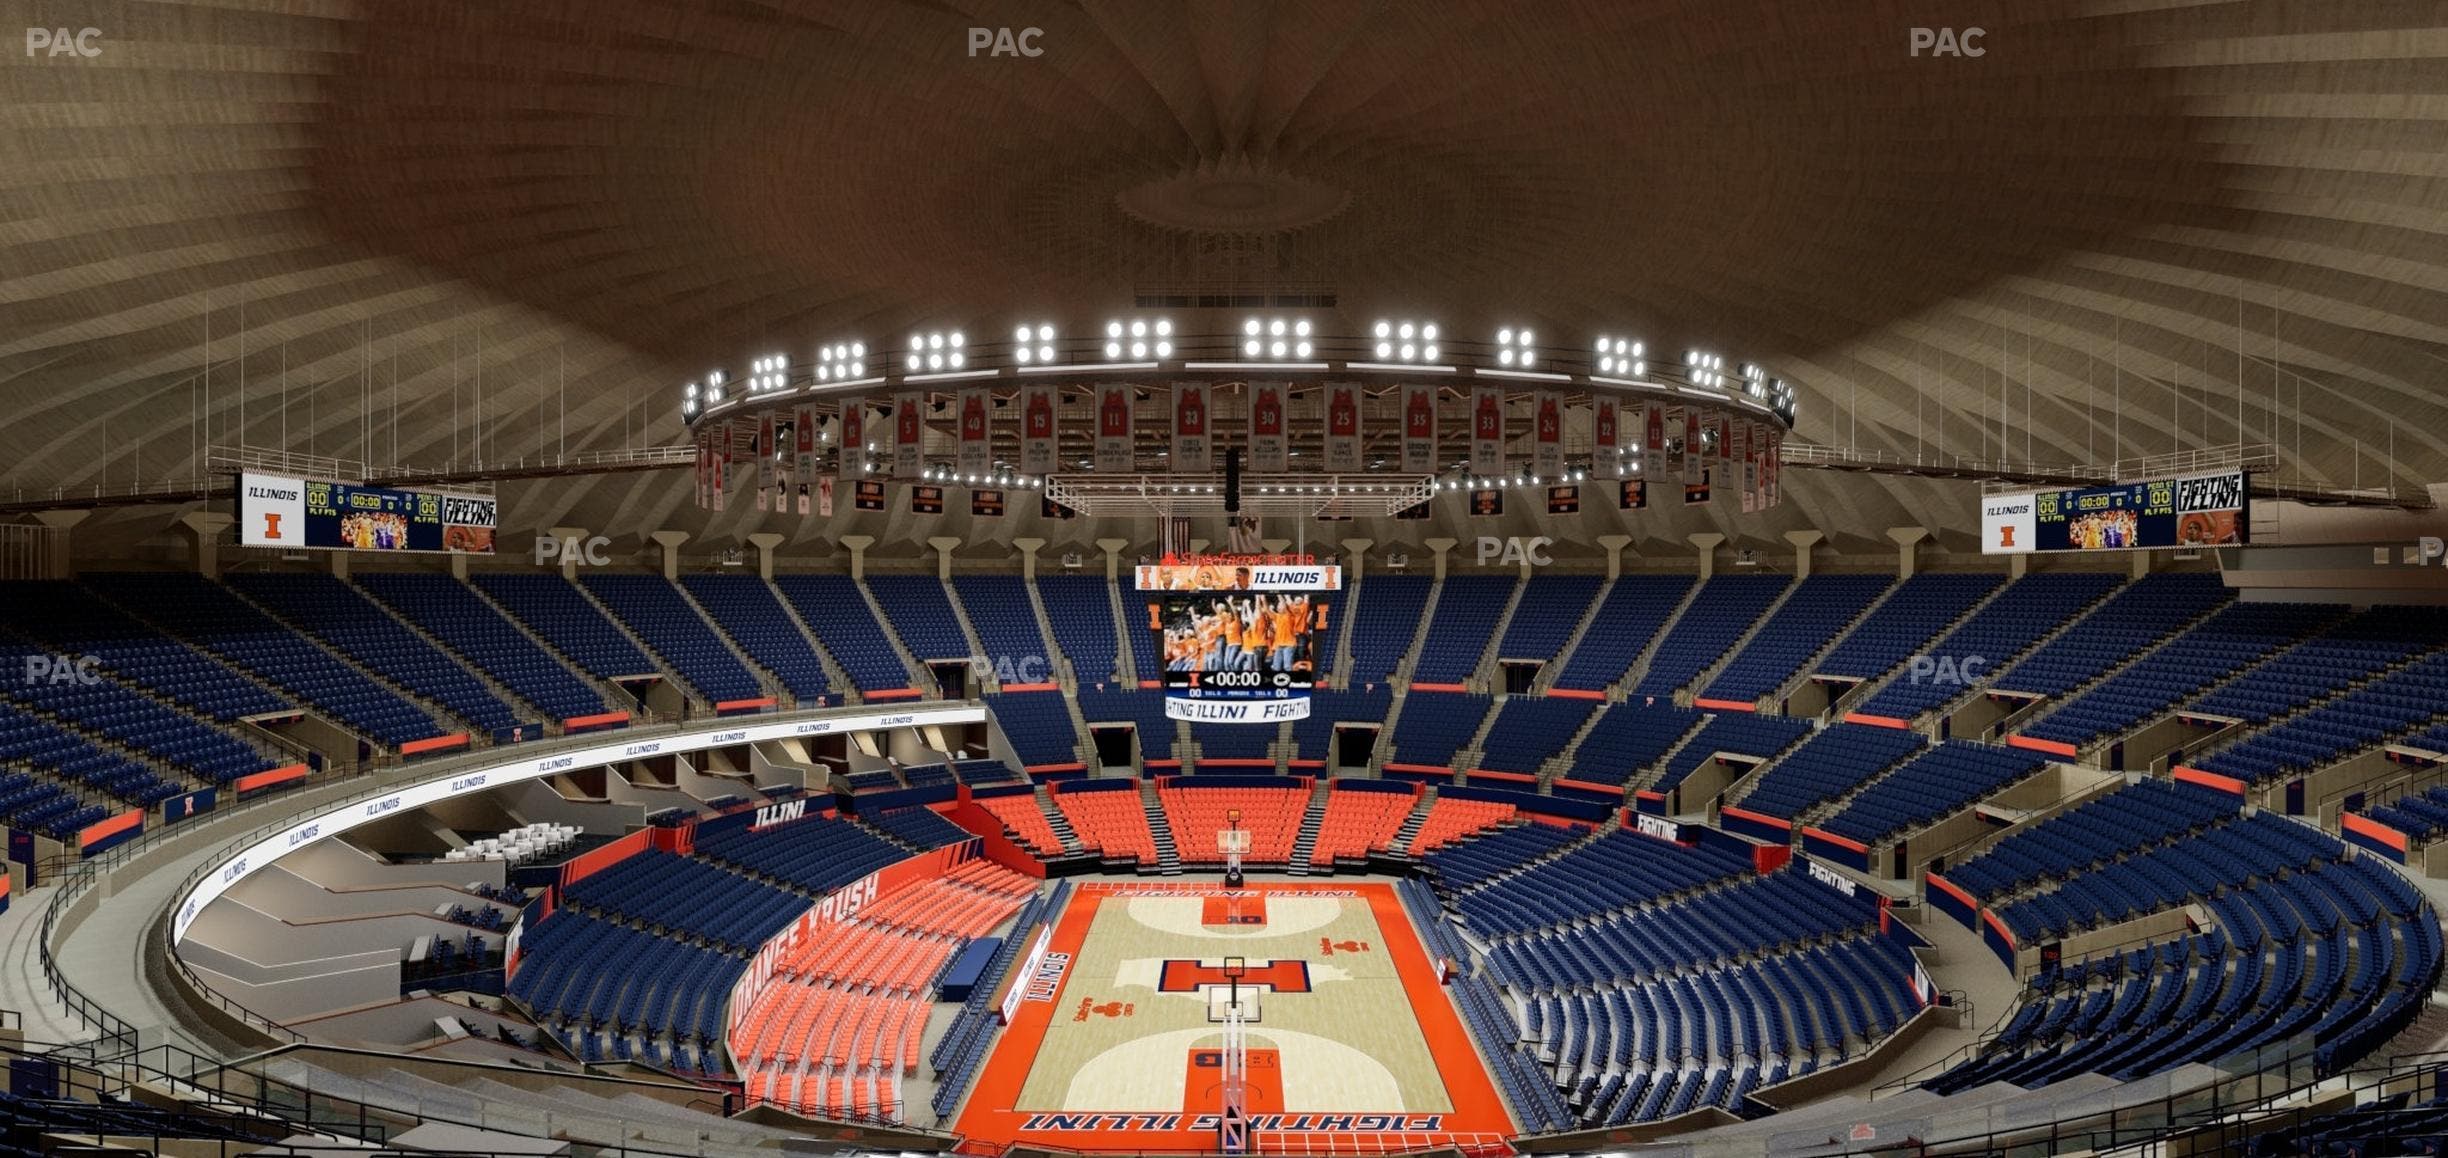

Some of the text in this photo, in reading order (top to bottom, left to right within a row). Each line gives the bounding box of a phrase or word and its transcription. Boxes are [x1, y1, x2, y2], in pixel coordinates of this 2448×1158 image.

[969, 417, 980, 430] 40
[1108, 413, 1119, 426] 11
[1262, 411, 1275, 425] 30
[1336, 411, 1349, 425] 25
[1414, 413, 1426, 426] 35
[1483, 416, 1494, 430] 33
[249, 487, 298, 501] ILLINOIS
[2180, 477, 2240, 501] FIGHTING
[309, 491, 327, 505] 00
[337, 495, 343, 504] 0
[353, 496, 380, 507] 00:00
[2081, 496, 2108, 508] 00:00
[2135, 495, 2141, 504] 0
[2152, 491, 2170, 504] 00
[2179, 491, 2242, 510] ILLINI
[406, 502, 412, 510] 0
[421, 502, 437, 514] 00
[446, 498, 495, 515] FIGHTING
[1987, 505, 2029, 516] ILLINOIS
[2040, 502, 2055, 514] 00
[2066, 501, 2072, 510] 0
[265, 513, 281, 539] I
[2000, 526, 2015, 547] I
[1254, 572, 1319, 584] ILLINOIS
[1216, 672, 1260, 686] 00:00
[1189, 689, 1202, 698] 00
[1275, 689, 1288, 698] 00
[1197, 704, 1249, 718] ILLINI
[881, 716, 914, 725] ILLINOIS
[797, 723, 831, 733] ILLINOIS
[712, 732, 746, 743] ILLINOIS
[626, 743, 660, 756] ILLINOIS
[538, 757, 573, 772] ILLINOIS
[452, 775, 486, 792] ILLINOIS
[366, 797, 400, 816] ILLINOIS
[755, 799, 806, 828] ILLINI
[1638, 814, 1678, 842] FIGHTING
[289, 824, 320, 847] ILLINOIS
[1809, 861, 1856, 897] FIGHTING
[1024, 951, 1072, 1003] ILLINOIS
[1018, 1113, 1184, 1132] ILLINI
